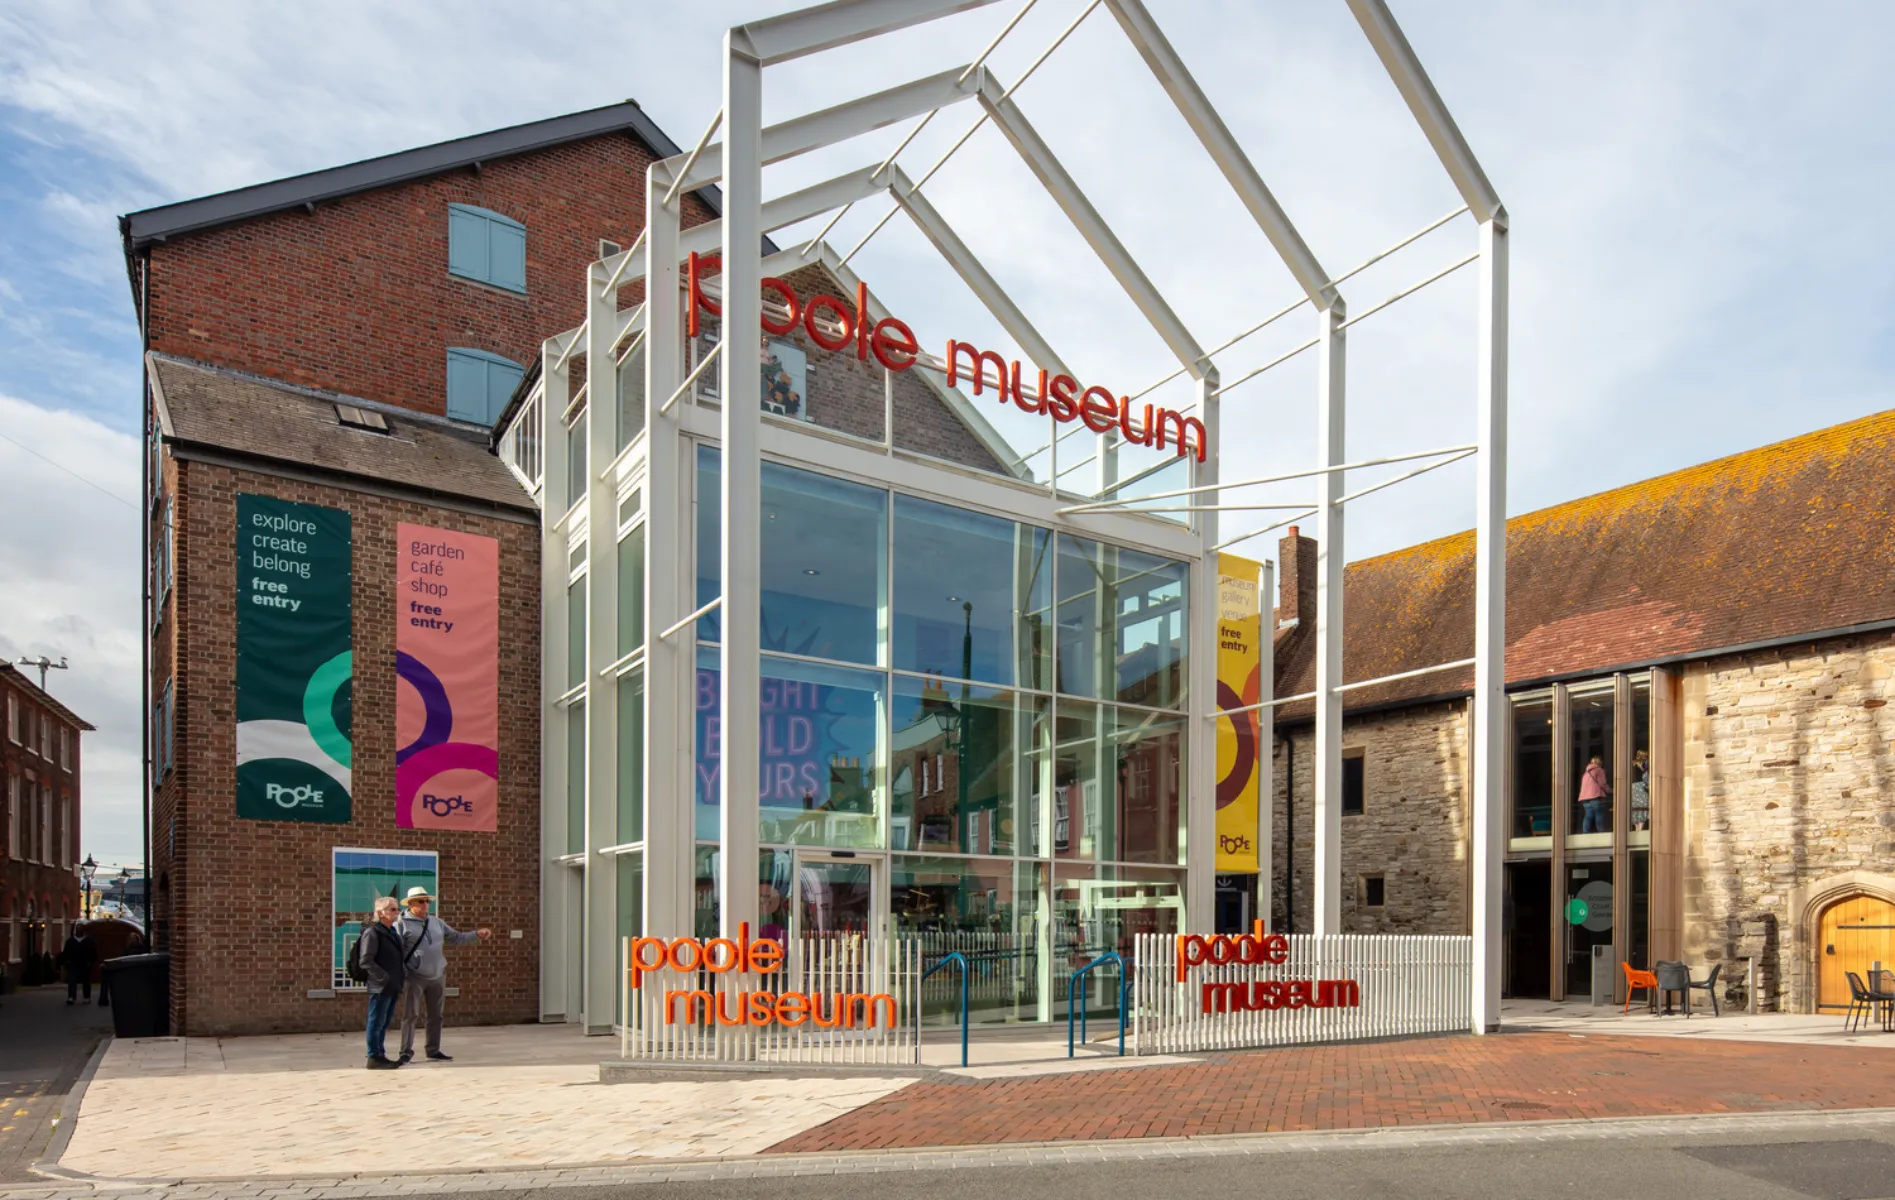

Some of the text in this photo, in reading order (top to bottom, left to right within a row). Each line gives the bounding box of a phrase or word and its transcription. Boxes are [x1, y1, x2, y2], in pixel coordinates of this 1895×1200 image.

[688, 252, 1207, 463] poole museum
[252, 513, 316, 534] explore
[253, 534, 307, 554] create
[411, 541, 465, 560] garden
[253, 551, 311, 578] belong
[411, 559, 444, 576] café
[252, 577, 289, 594] free
[411, 577, 449, 599] shop
[1222, 576, 1255, 590] museum
[252, 594, 302, 612] entry
[410, 600, 443, 616] free
[410, 616, 454, 633] entry
[1221, 626, 1242, 639] free
[1221, 640, 1248, 654] entry
[696, 671, 819, 711] BGHT
[704, 714, 813, 759] BLD
[696, 760, 820, 801] YURS
[266, 783, 324, 808] POOLE
[423, 794, 473, 817] POOLE
[1220, 834, 1250, 855] POOLE
[631, 921, 785, 989] poole
[1177, 919, 1289, 983] poole
[1203, 980, 1359, 1013] museum
[665, 990, 897, 1029] museum
